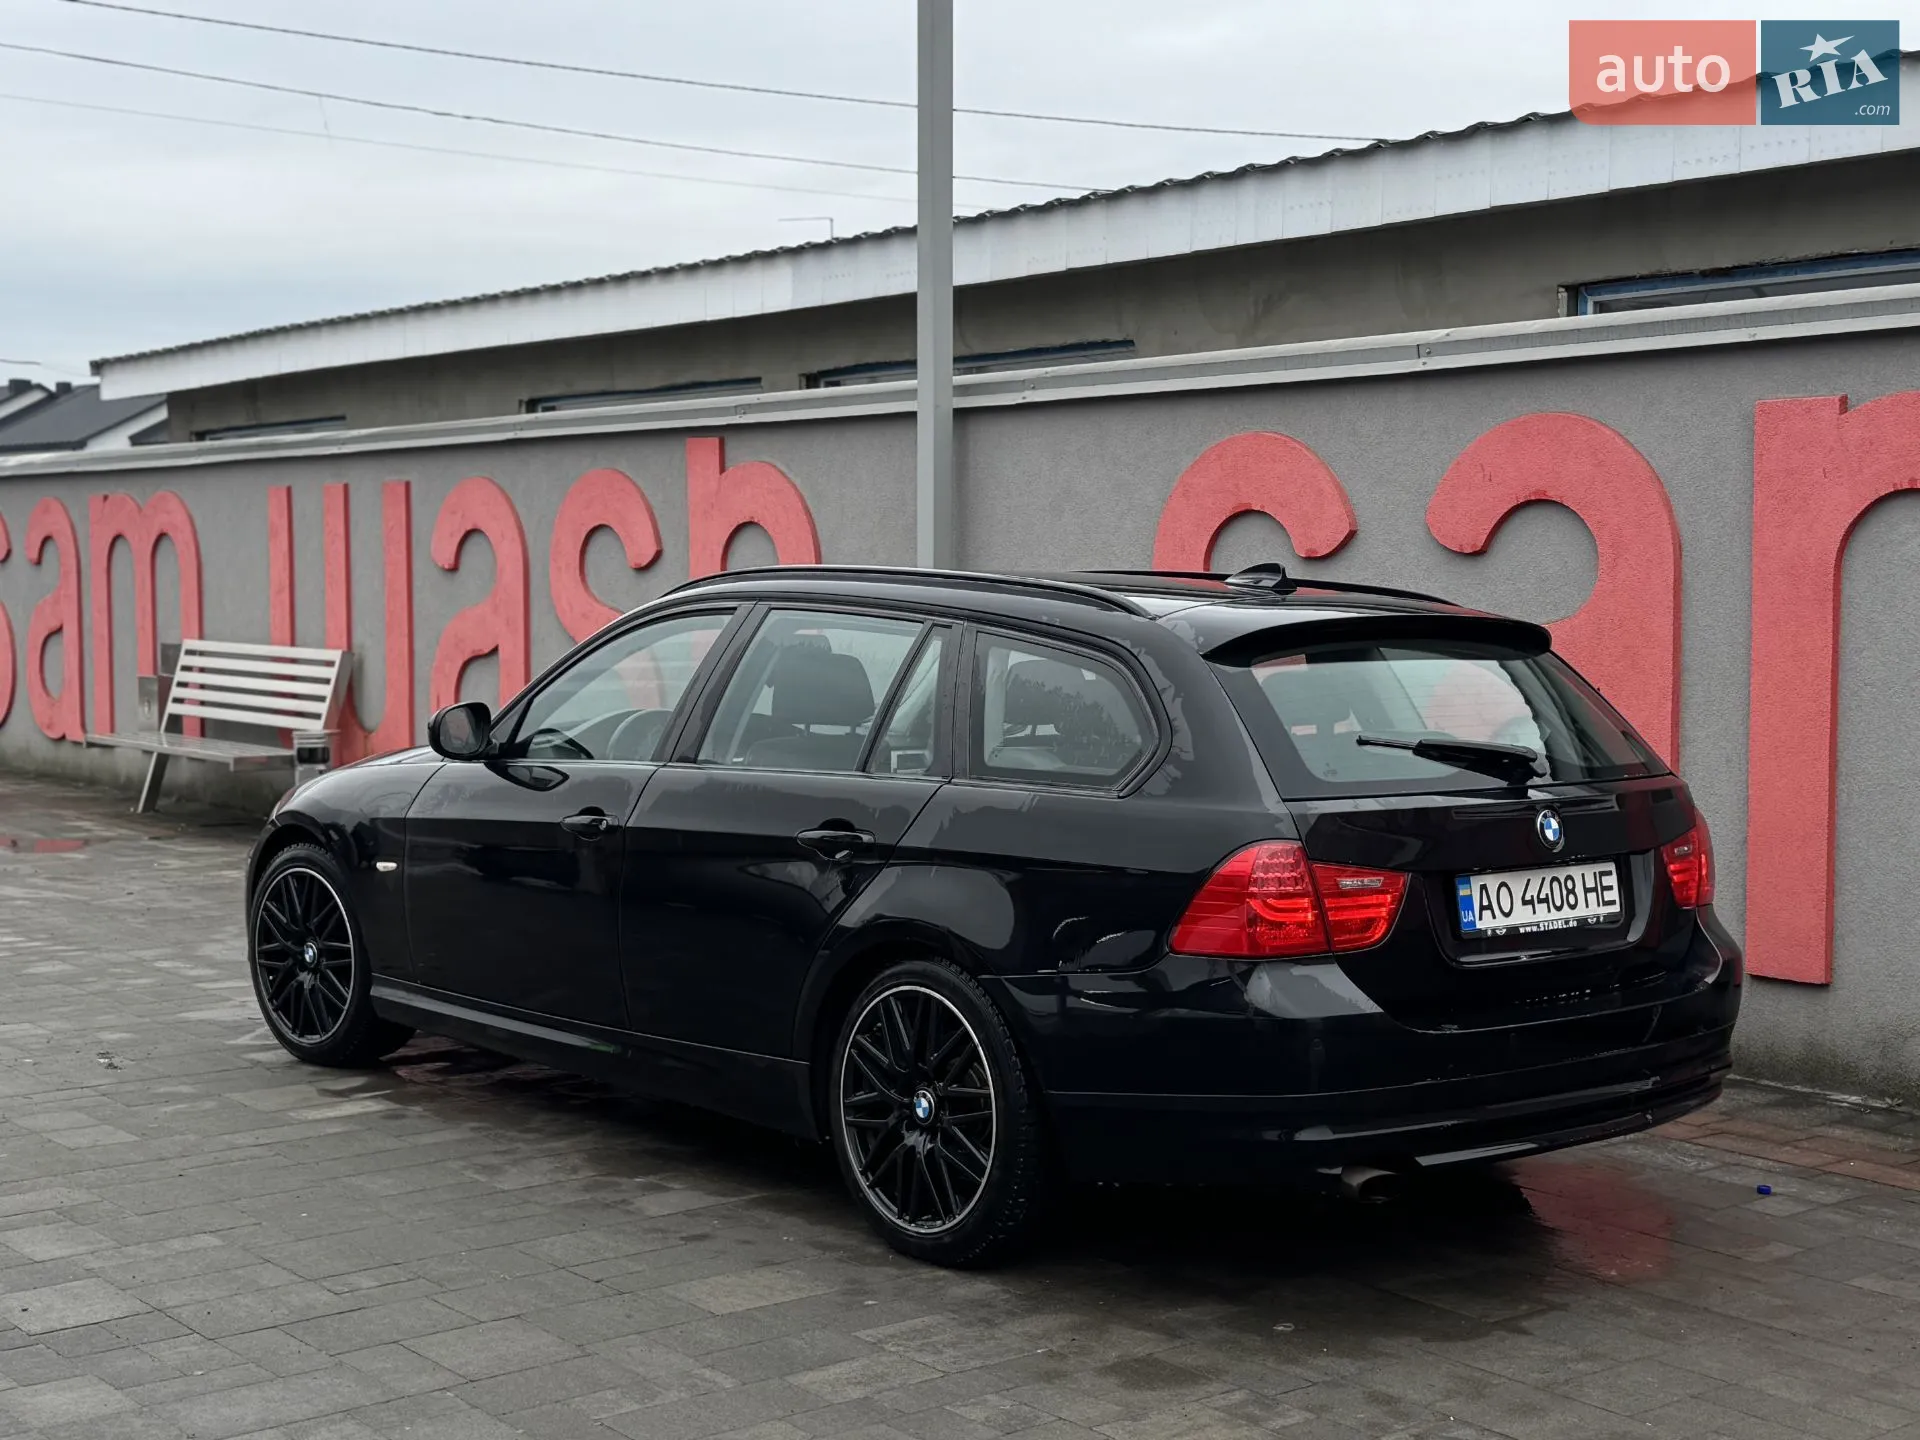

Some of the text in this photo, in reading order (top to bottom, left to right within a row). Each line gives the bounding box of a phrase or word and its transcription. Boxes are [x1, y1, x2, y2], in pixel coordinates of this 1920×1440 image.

[1478, 869, 1617, 922] AO 4408 HE
[1461, 910, 1475, 922] UA
[1518, 919, 1578, 934] www.STADEL.de
